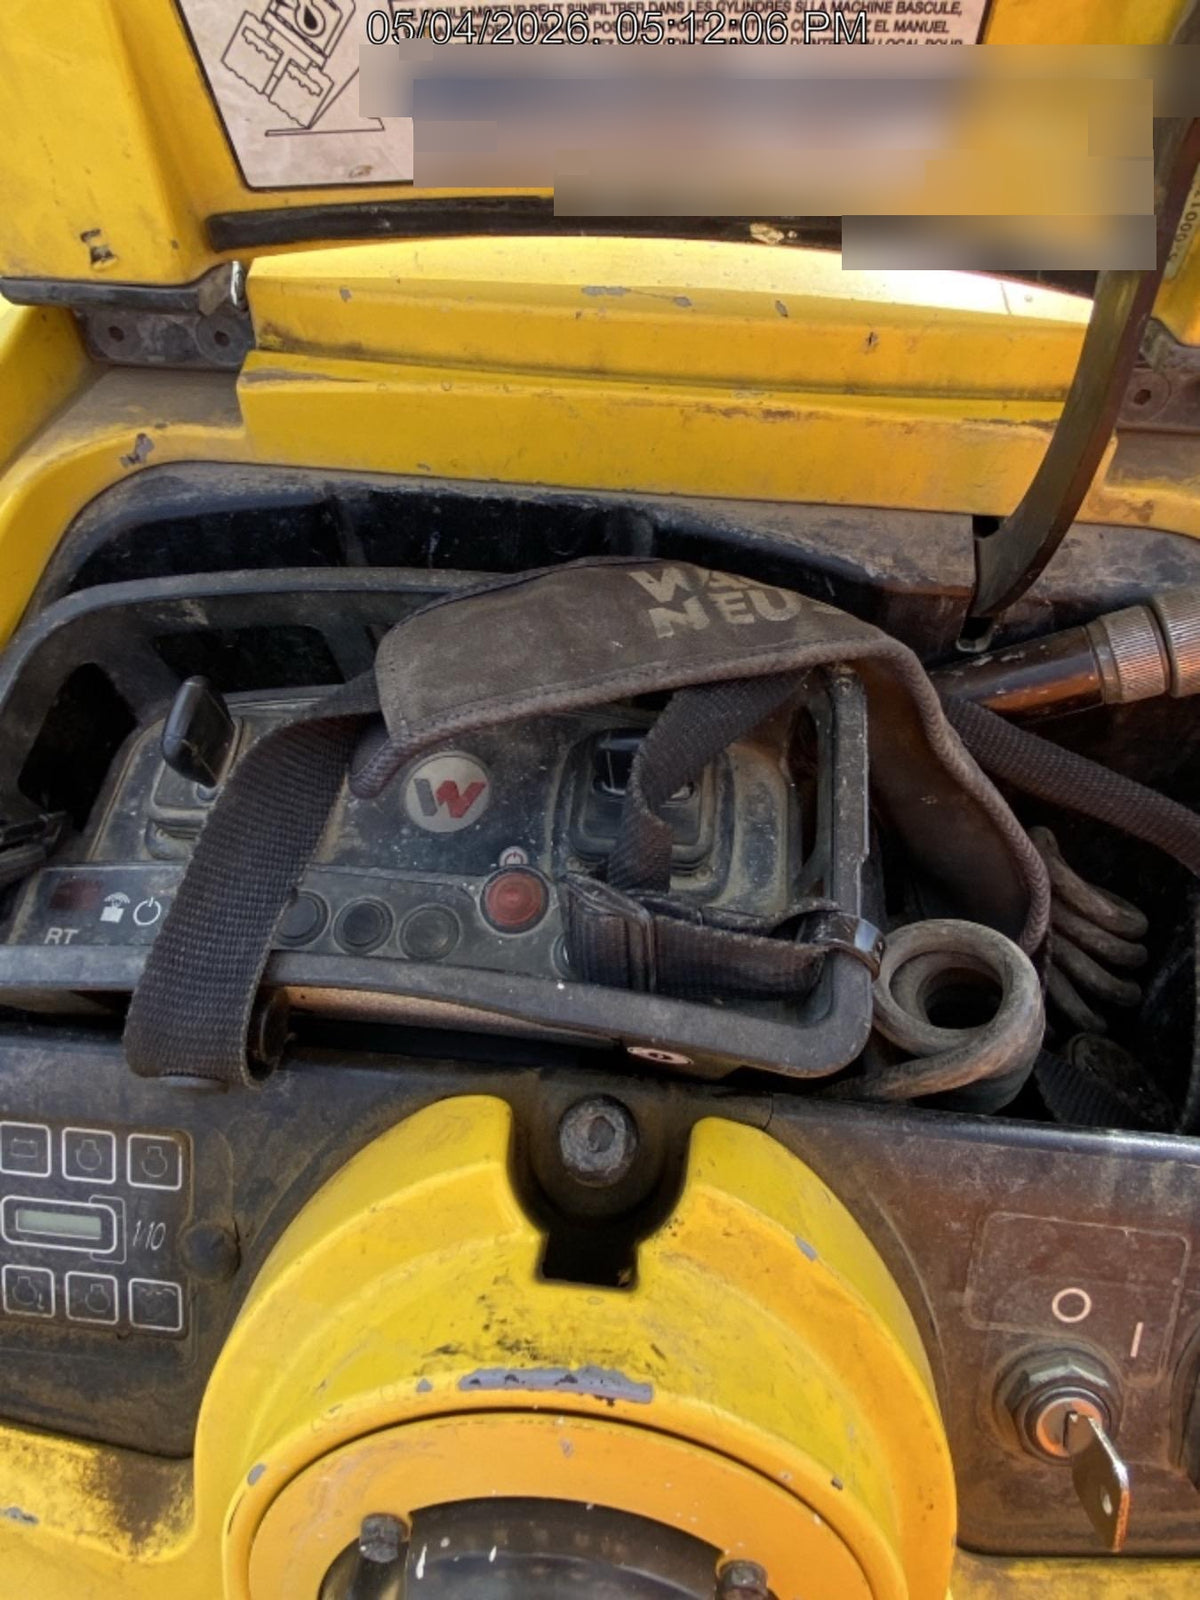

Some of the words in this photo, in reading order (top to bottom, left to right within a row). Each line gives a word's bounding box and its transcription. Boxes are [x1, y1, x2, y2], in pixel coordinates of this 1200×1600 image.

[648, 1, 685, 13] DANS
[687, 1, 713, 13] LES
[716, 1, 791, 13] CYLINDRES
[830, 0, 892, 13] MACHINE
[895, 1, 963, 16] BASCULE,
[874, 20, 889, 32] EL
[893, 20, 949, 33] MANUEL
[44, 927, 79, 945] RT
